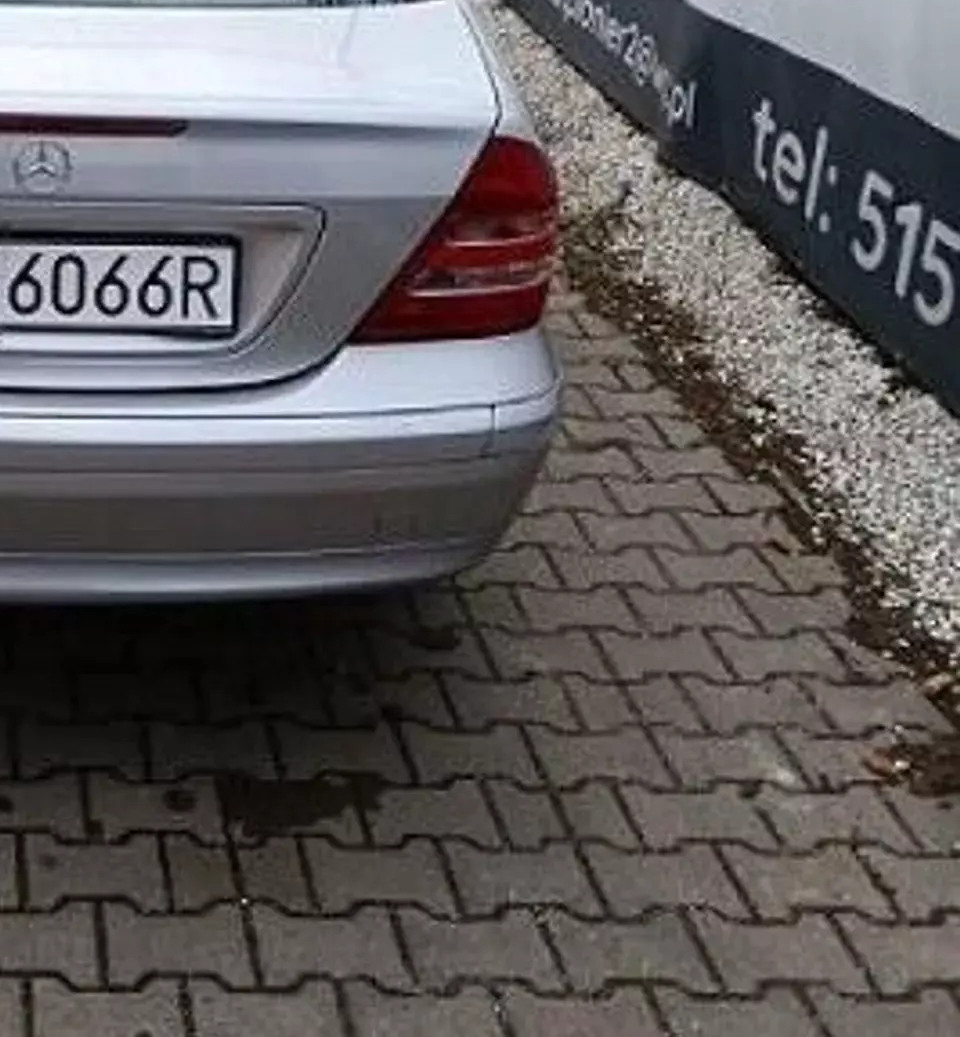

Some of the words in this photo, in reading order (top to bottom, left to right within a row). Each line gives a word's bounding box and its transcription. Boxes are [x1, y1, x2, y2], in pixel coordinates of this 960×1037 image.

[7, 251, 221, 319] 6066R
[753, 98, 838, 233] tel:
[851, 169, 960, 326] 515
